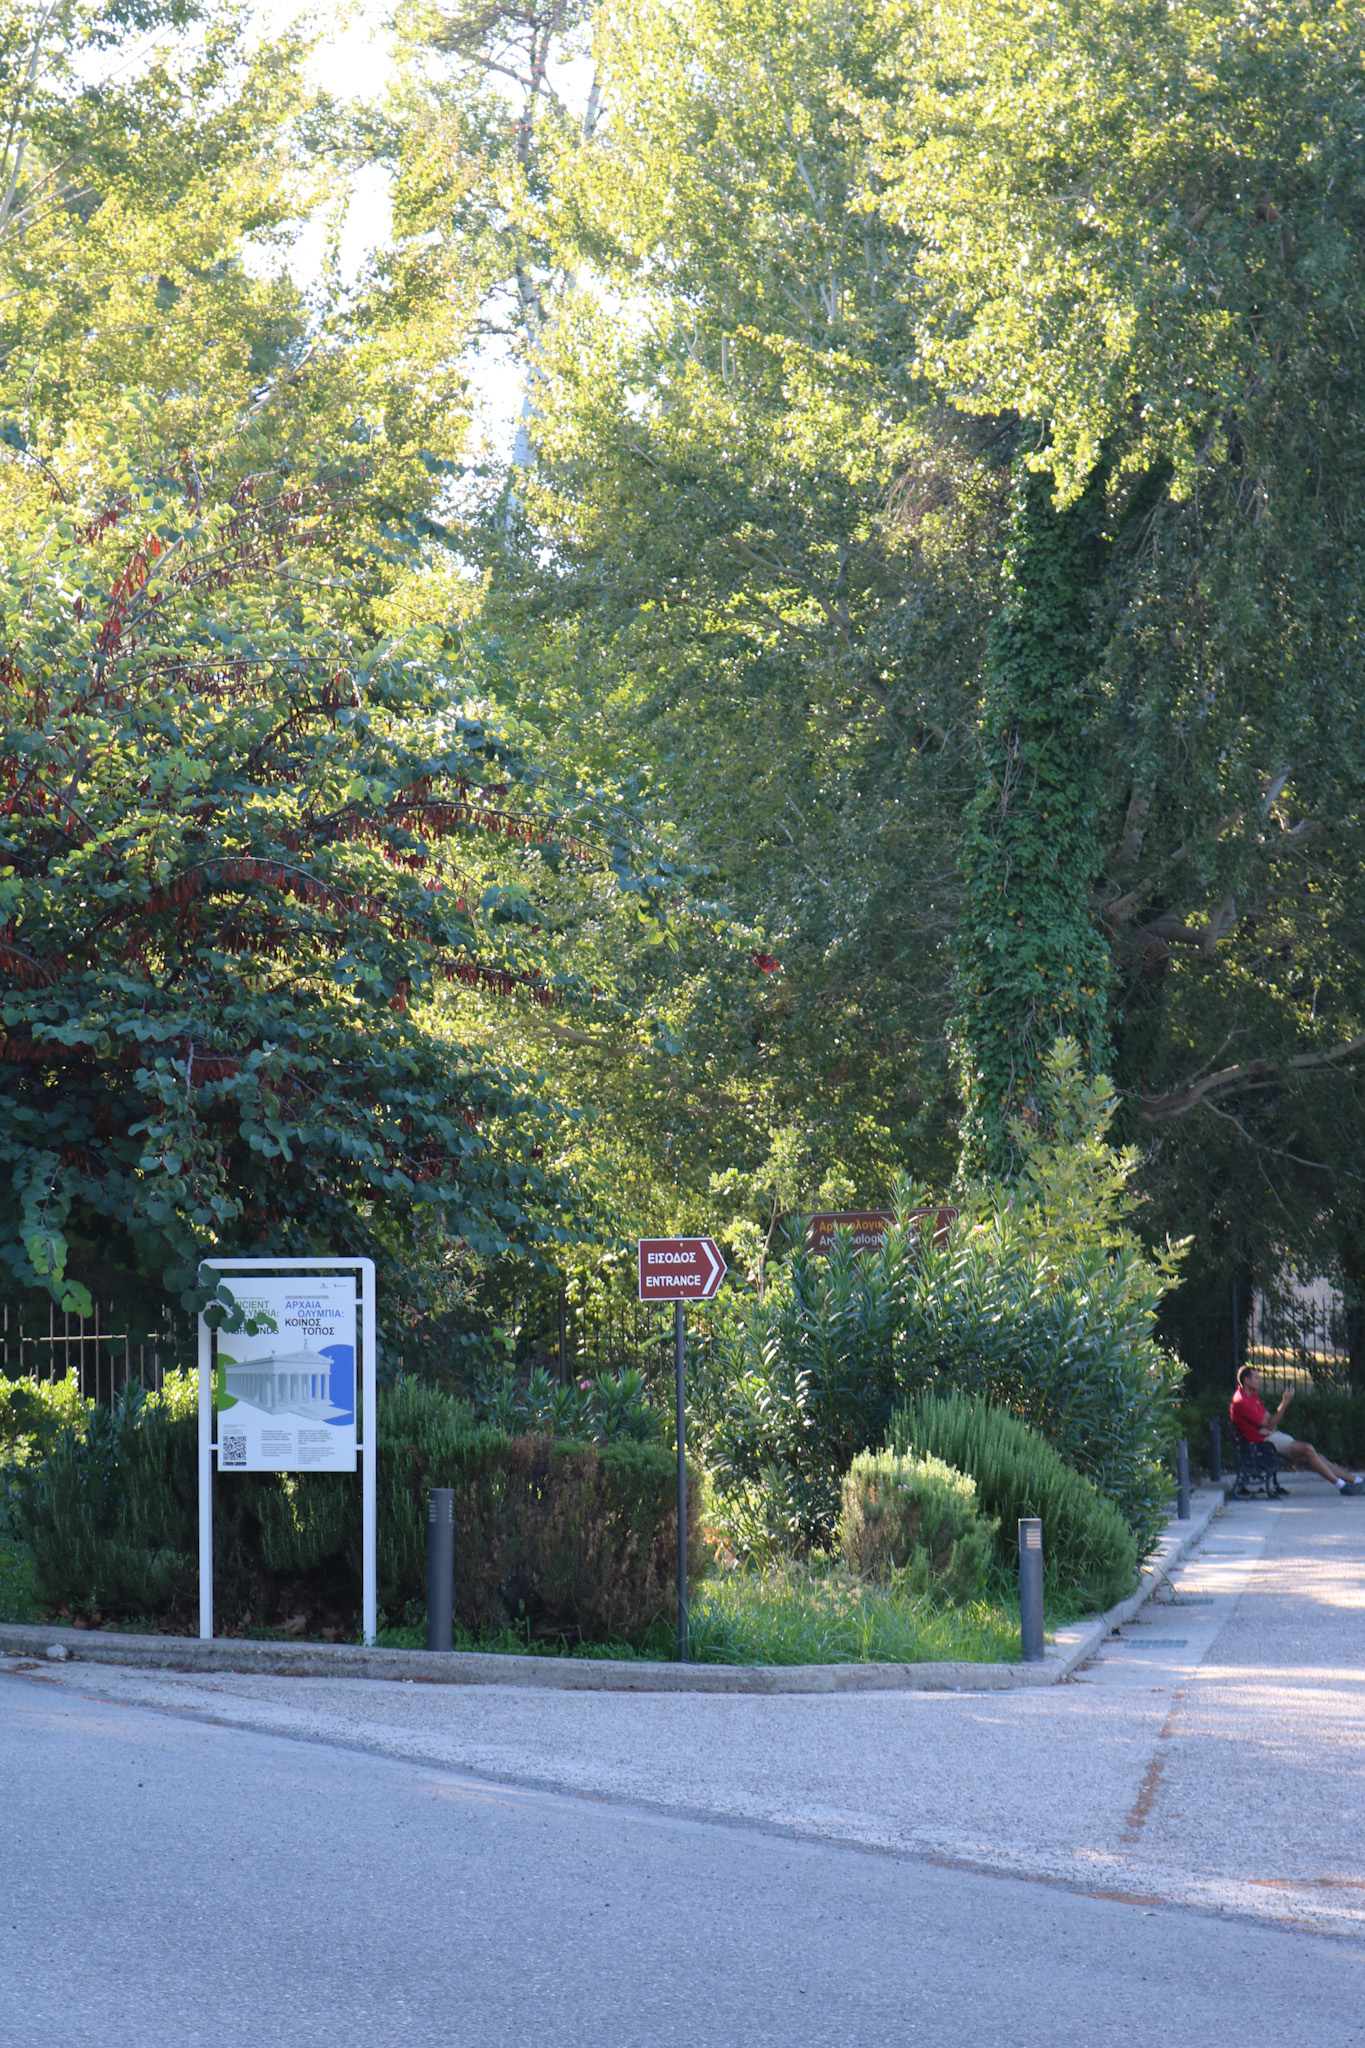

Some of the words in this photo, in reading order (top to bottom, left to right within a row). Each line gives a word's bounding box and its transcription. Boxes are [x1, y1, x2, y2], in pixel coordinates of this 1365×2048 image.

[647, 1252, 696, 1264] ΕΙΣΟΔΟΣ
[645, 1274, 701, 1287] ENTRANCE
[235, 1300, 270, 1309] NCIENT
[285, 1301, 322, 1309] ΑΡΧΑΙΑ
[297, 1309, 344, 1318] ΟΛΥΜΠΙΑ:
[284, 1318, 322, 1327] ΚΟΙΝΟΣ
[301, 1327, 335, 1336] ΤΟΠΟΣ
